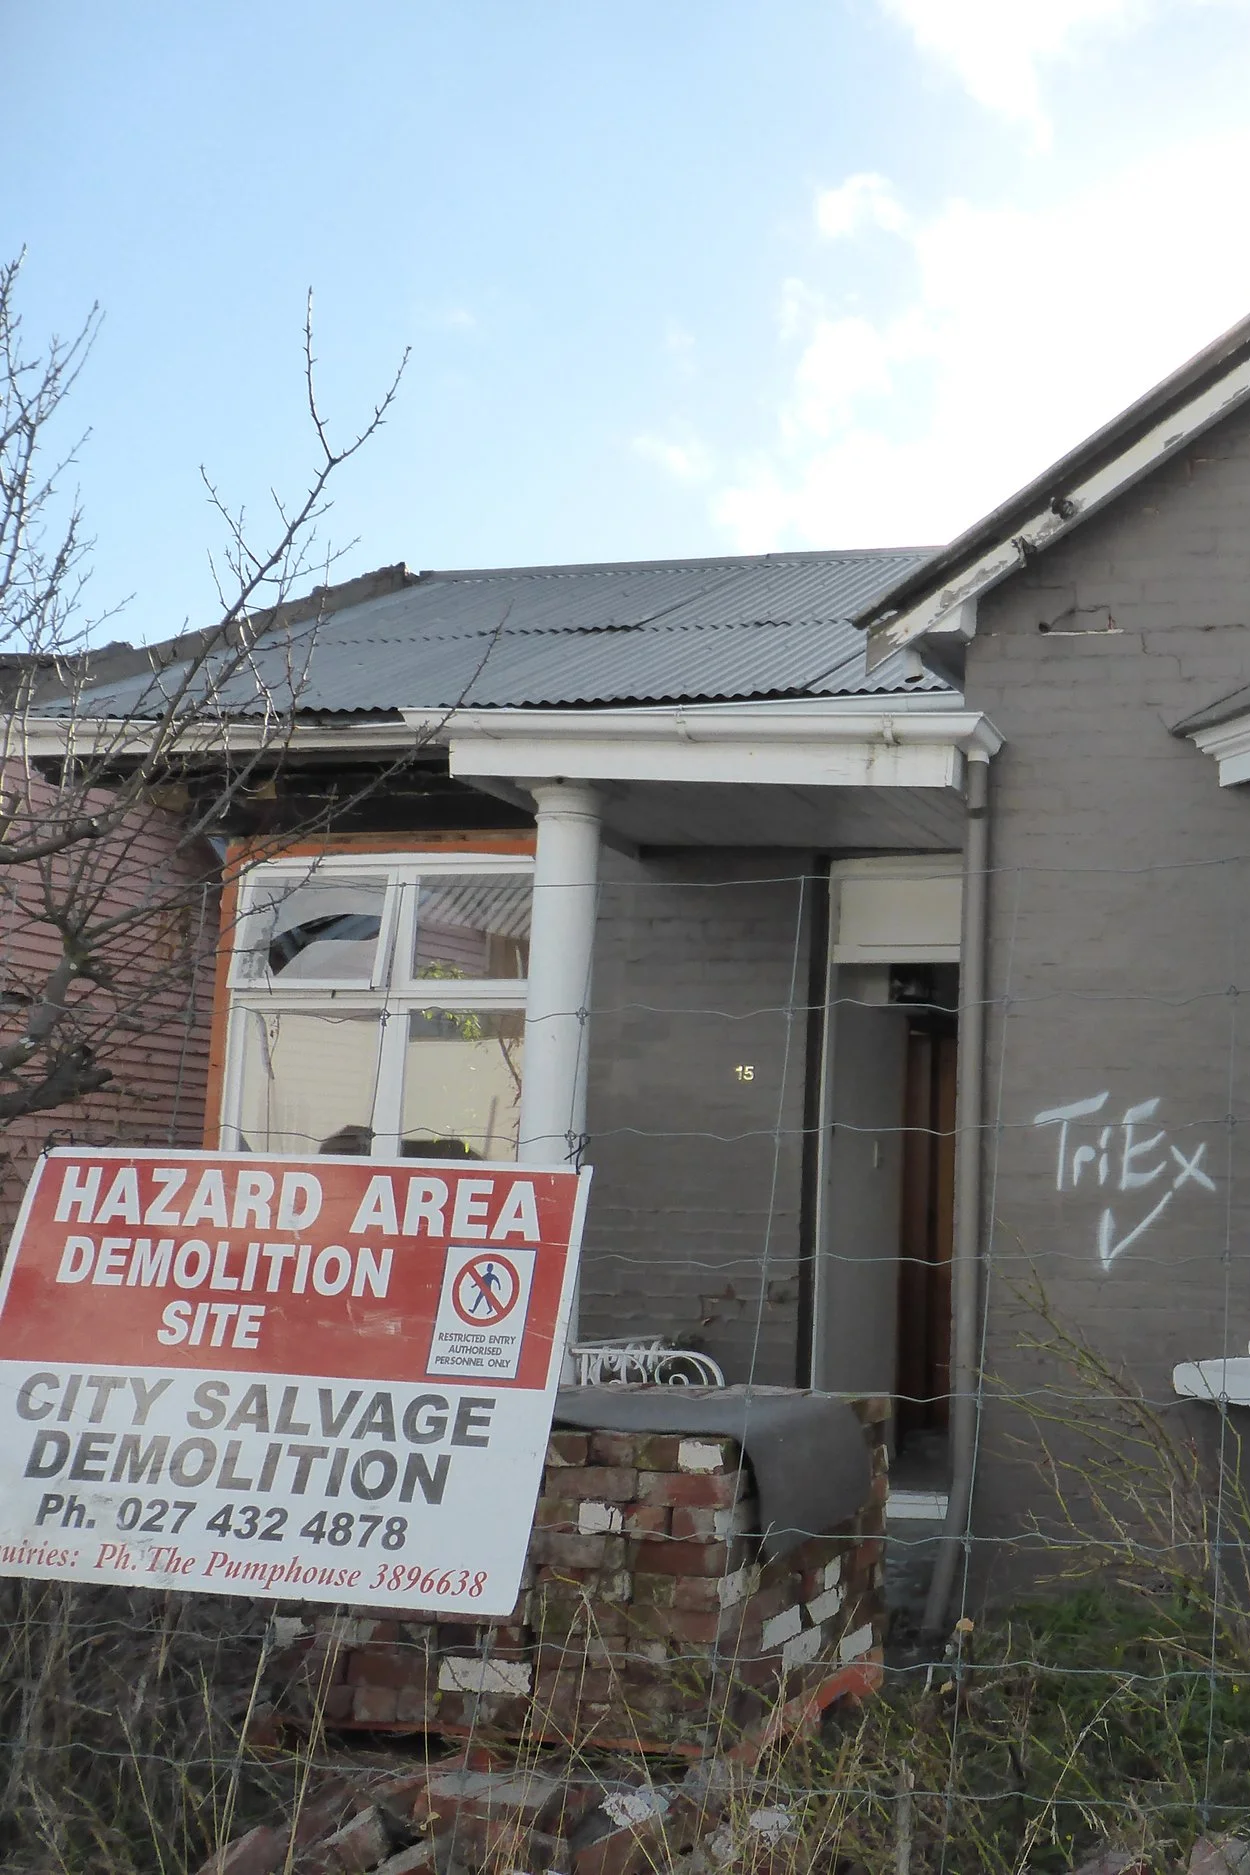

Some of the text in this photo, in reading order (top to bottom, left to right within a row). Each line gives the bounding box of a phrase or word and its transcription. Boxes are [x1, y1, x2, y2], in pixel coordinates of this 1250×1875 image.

[734, 1065, 755, 1081] 15
[53, 1165, 541, 1242] HAZARD AREA
[55, 1236, 394, 1299] DEMOLITION
[157, 1300, 266, 1349] SITE
[438, 1332, 517, 1345] RESTRICTED ENTRY
[448, 1344, 502, 1356] AUTHORISED
[434, 1355, 511, 1368] PERSONNEL ONLY
[16, 1371, 497, 1449] CITY SALVAGE
[23, 1430, 453, 1506] DEMOLITION
[35, 1493, 409, 1551] Ph. 027 432 4878
[0, 1539, 488, 1598] uiries: Ph. The Pumphouse 3896638
